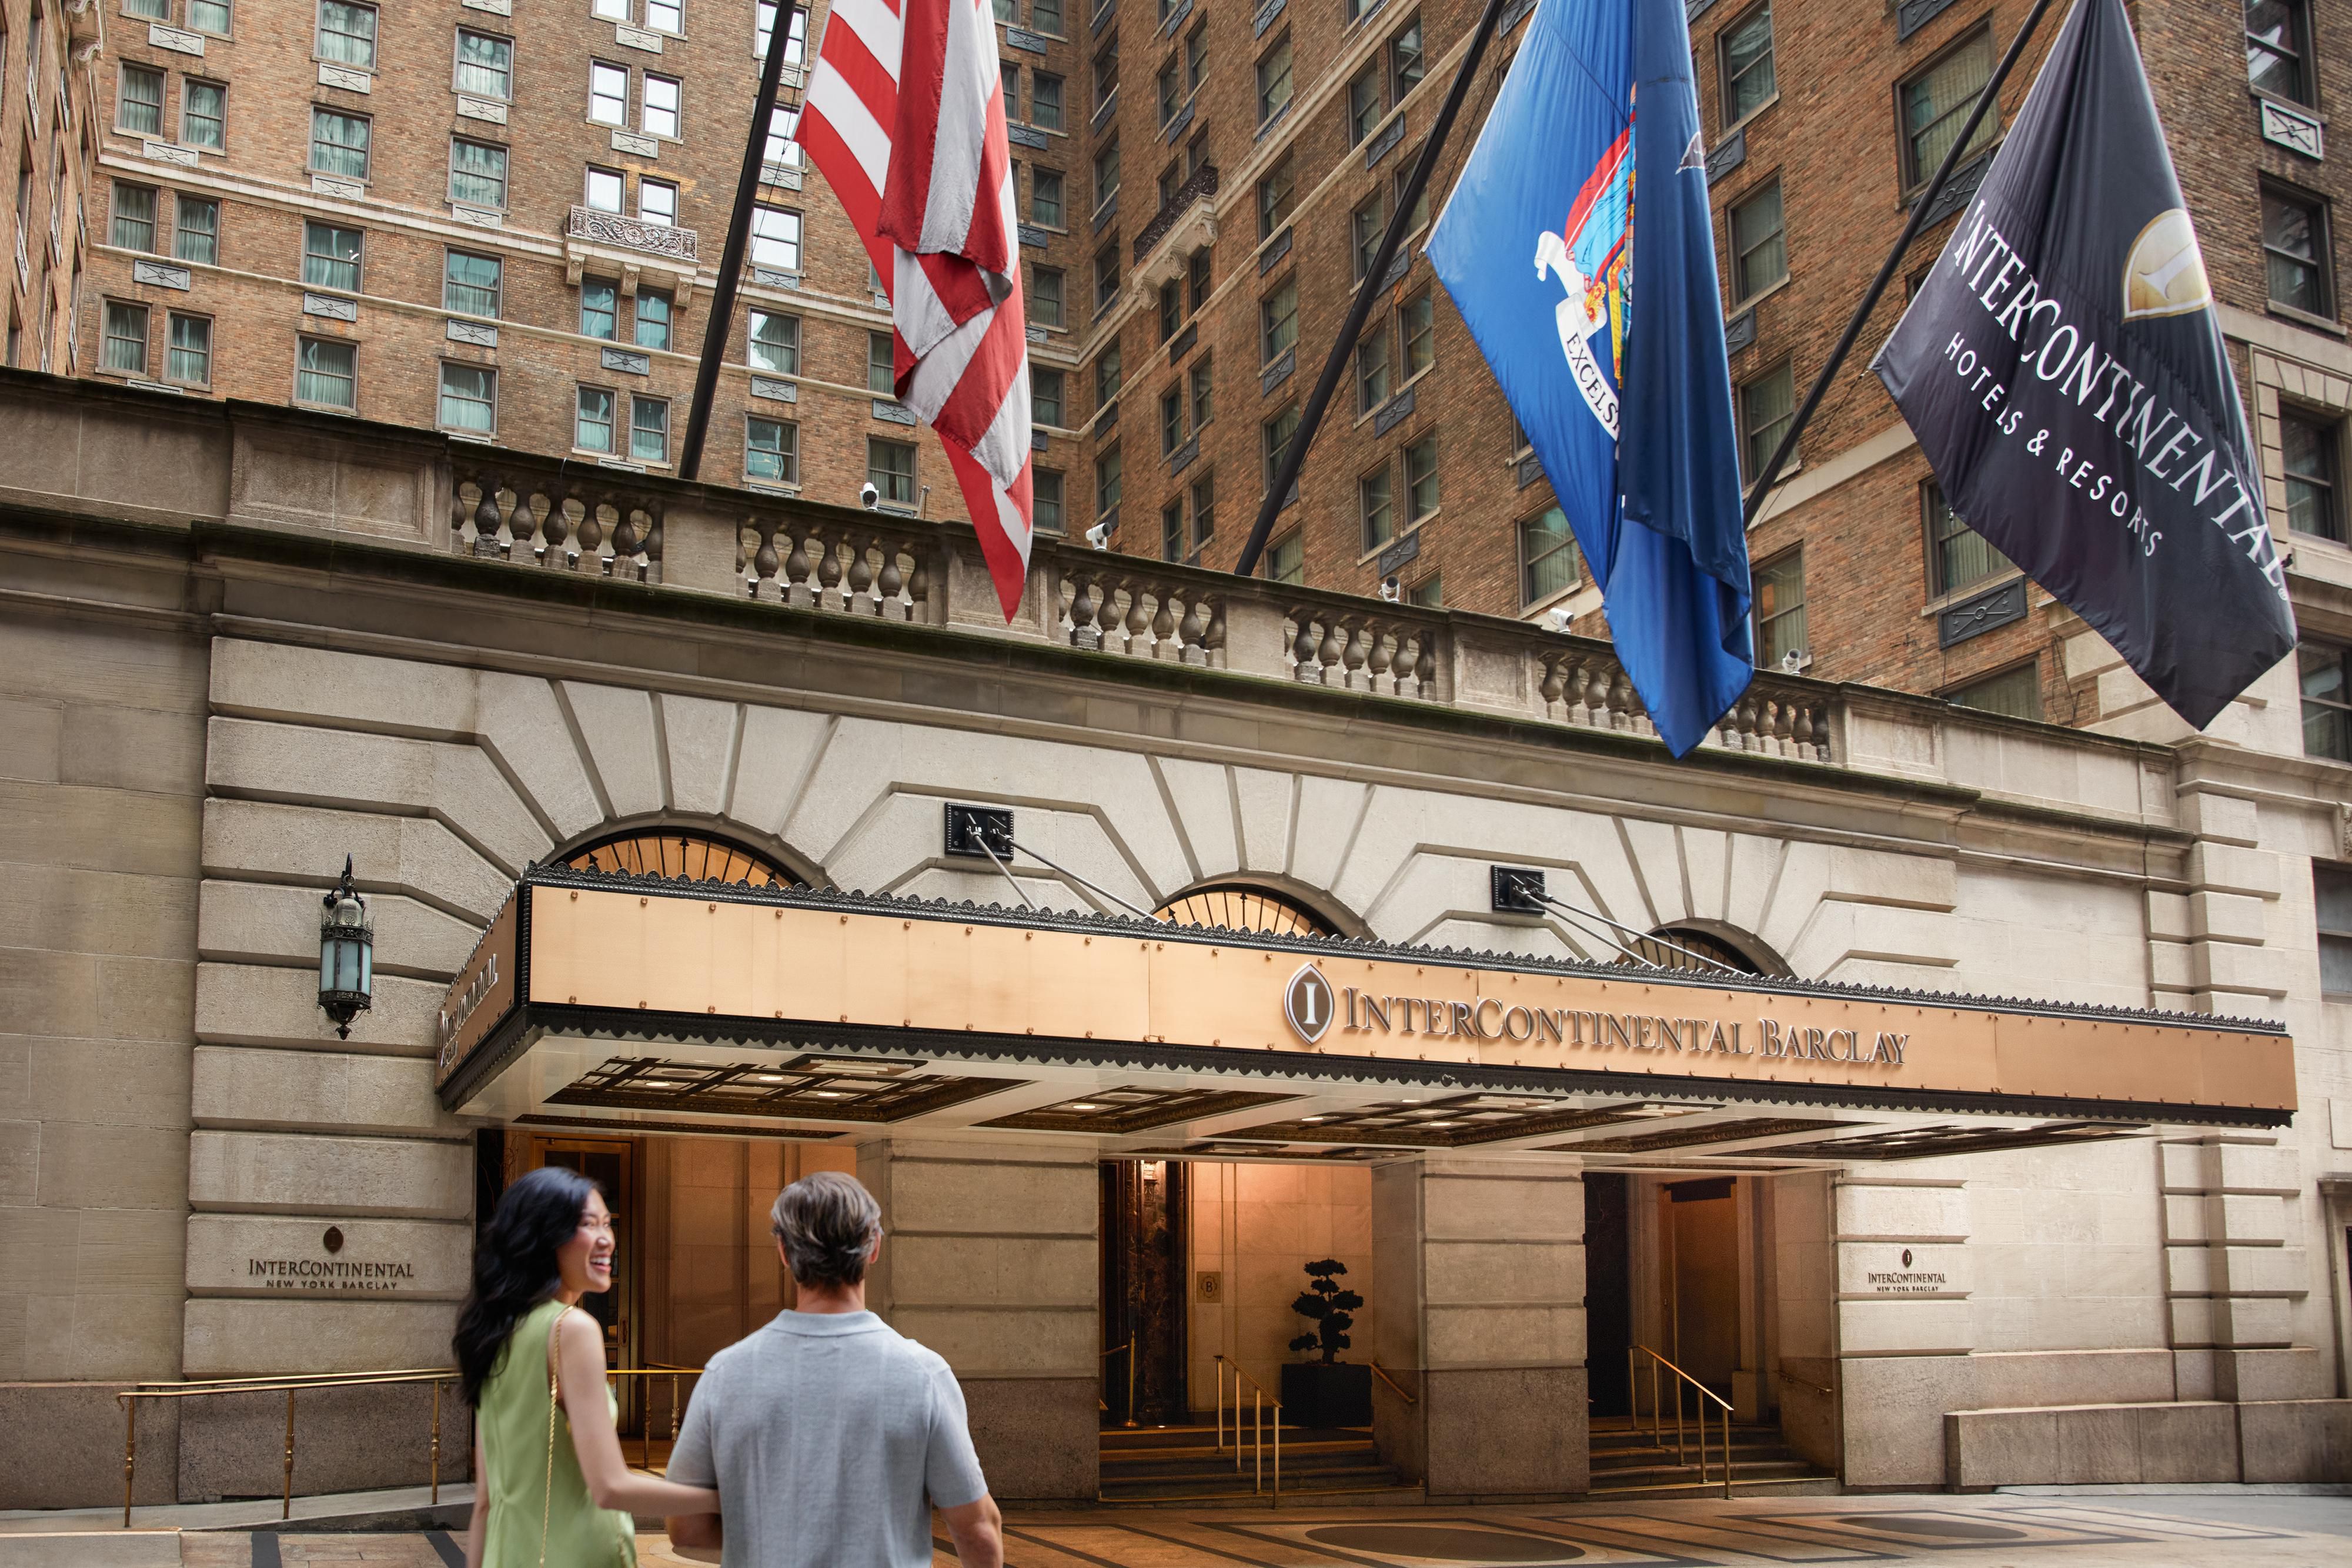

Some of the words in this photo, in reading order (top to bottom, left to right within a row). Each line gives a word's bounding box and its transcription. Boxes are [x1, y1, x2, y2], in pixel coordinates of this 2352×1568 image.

[1566, 333, 1619, 431] EXCELS
[1954, 199, 2280, 587] INTERCONTINENTAL
[1945, 332, 2023, 435] HOTELS
[2027, 430, 2049, 456] &
[2056, 447, 2163, 557] RESORTS
[1344, 987, 1753, 1054] INTERCONTINENTAL
[1759, 1019, 1910, 1065] BARCLAY
[249, 1259, 414, 1278] INTERCONTINENTAL
[267, 1279, 294, 1288] NEW
[302, 1281, 335, 1289] YORK
[342, 1281, 397, 1290] BARCLAY
[1868, 1272, 1946, 1284] INTERCONTINENTAL
